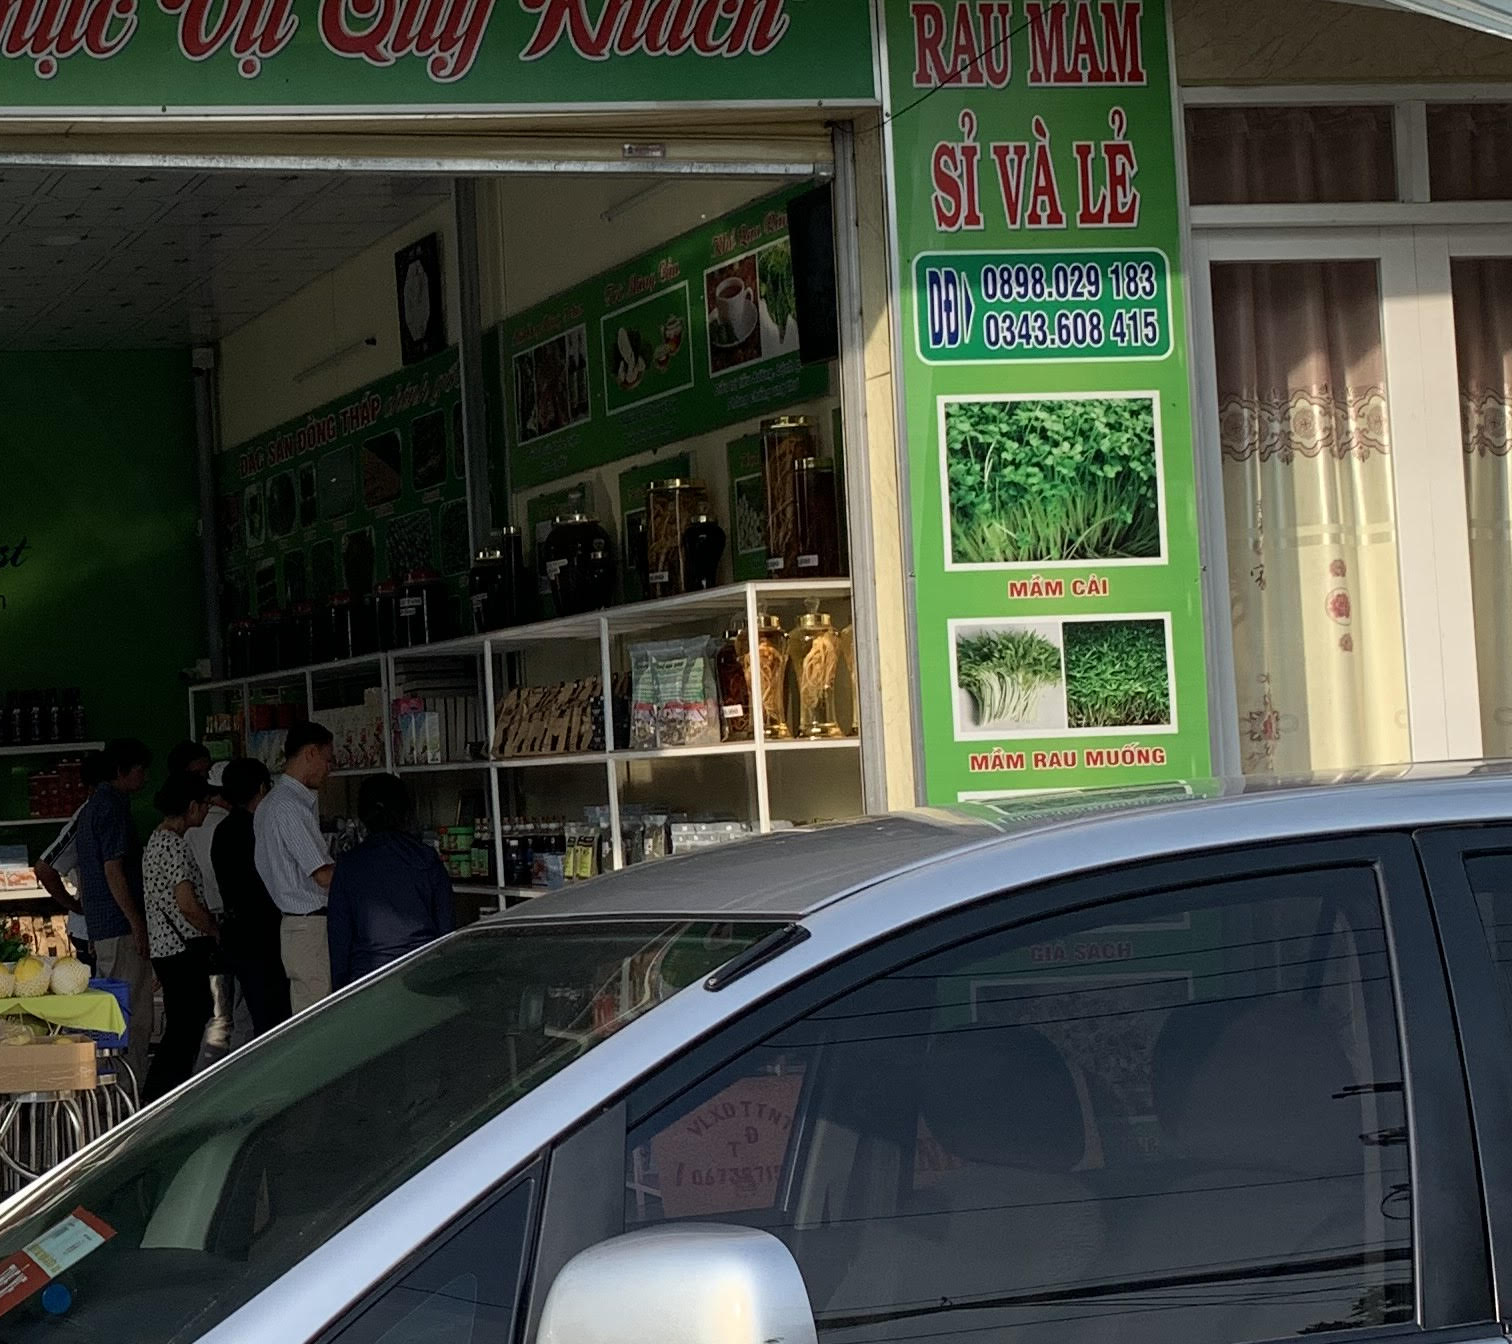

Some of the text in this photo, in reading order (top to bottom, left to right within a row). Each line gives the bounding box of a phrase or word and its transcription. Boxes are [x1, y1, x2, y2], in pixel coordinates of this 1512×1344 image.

[909, 0, 1013, 90] RAU
[931, 107, 1141, 232] SỈ VÀ LẺ
[981, 261, 1157, 303] 0898.029 183
[983, 309, 1159, 349] 0343.608 415
[1008, 574, 1110, 599] MẦM CẢI
[969, 742, 1167, 772] MẦM RAU MUỐNG
